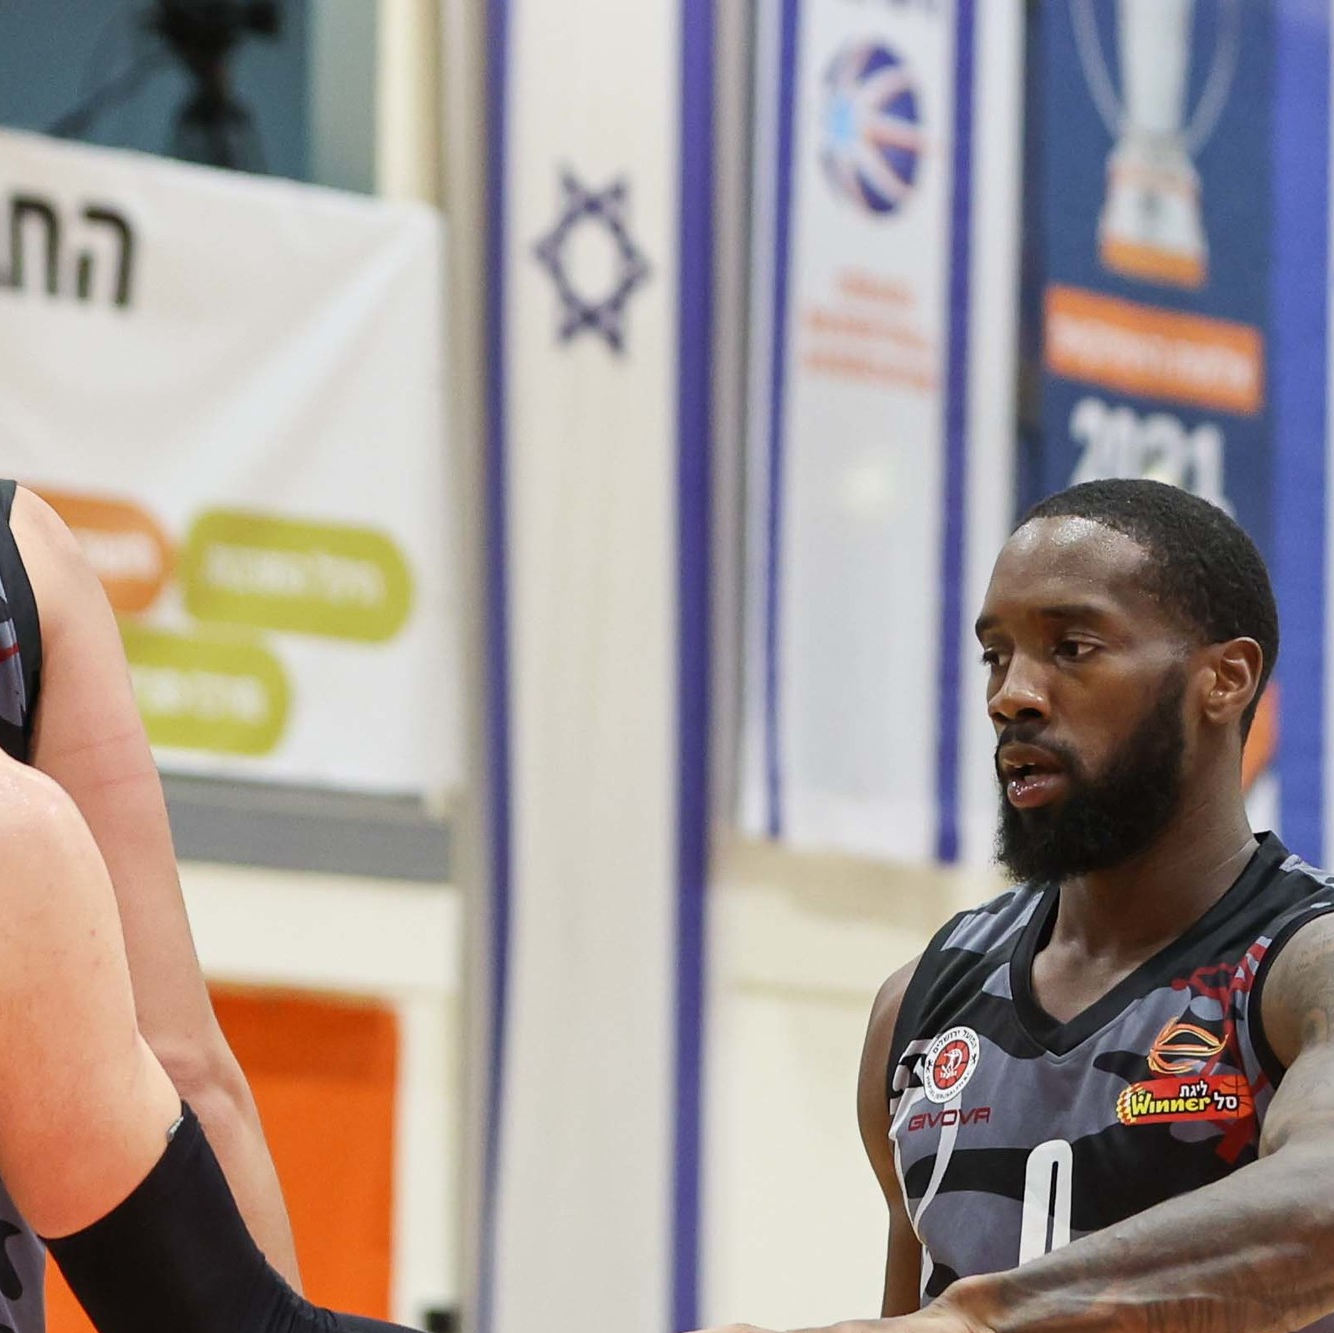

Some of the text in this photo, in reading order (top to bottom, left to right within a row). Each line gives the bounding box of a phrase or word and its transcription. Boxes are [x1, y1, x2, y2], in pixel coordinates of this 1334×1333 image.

[1179, 1080, 1208, 1097] ליגת
[1130, 1091, 1238, 1116] Winner סל
[907, 1106, 991, 1132] GIVOVA
[1018, 1138, 1073, 1268] 0
